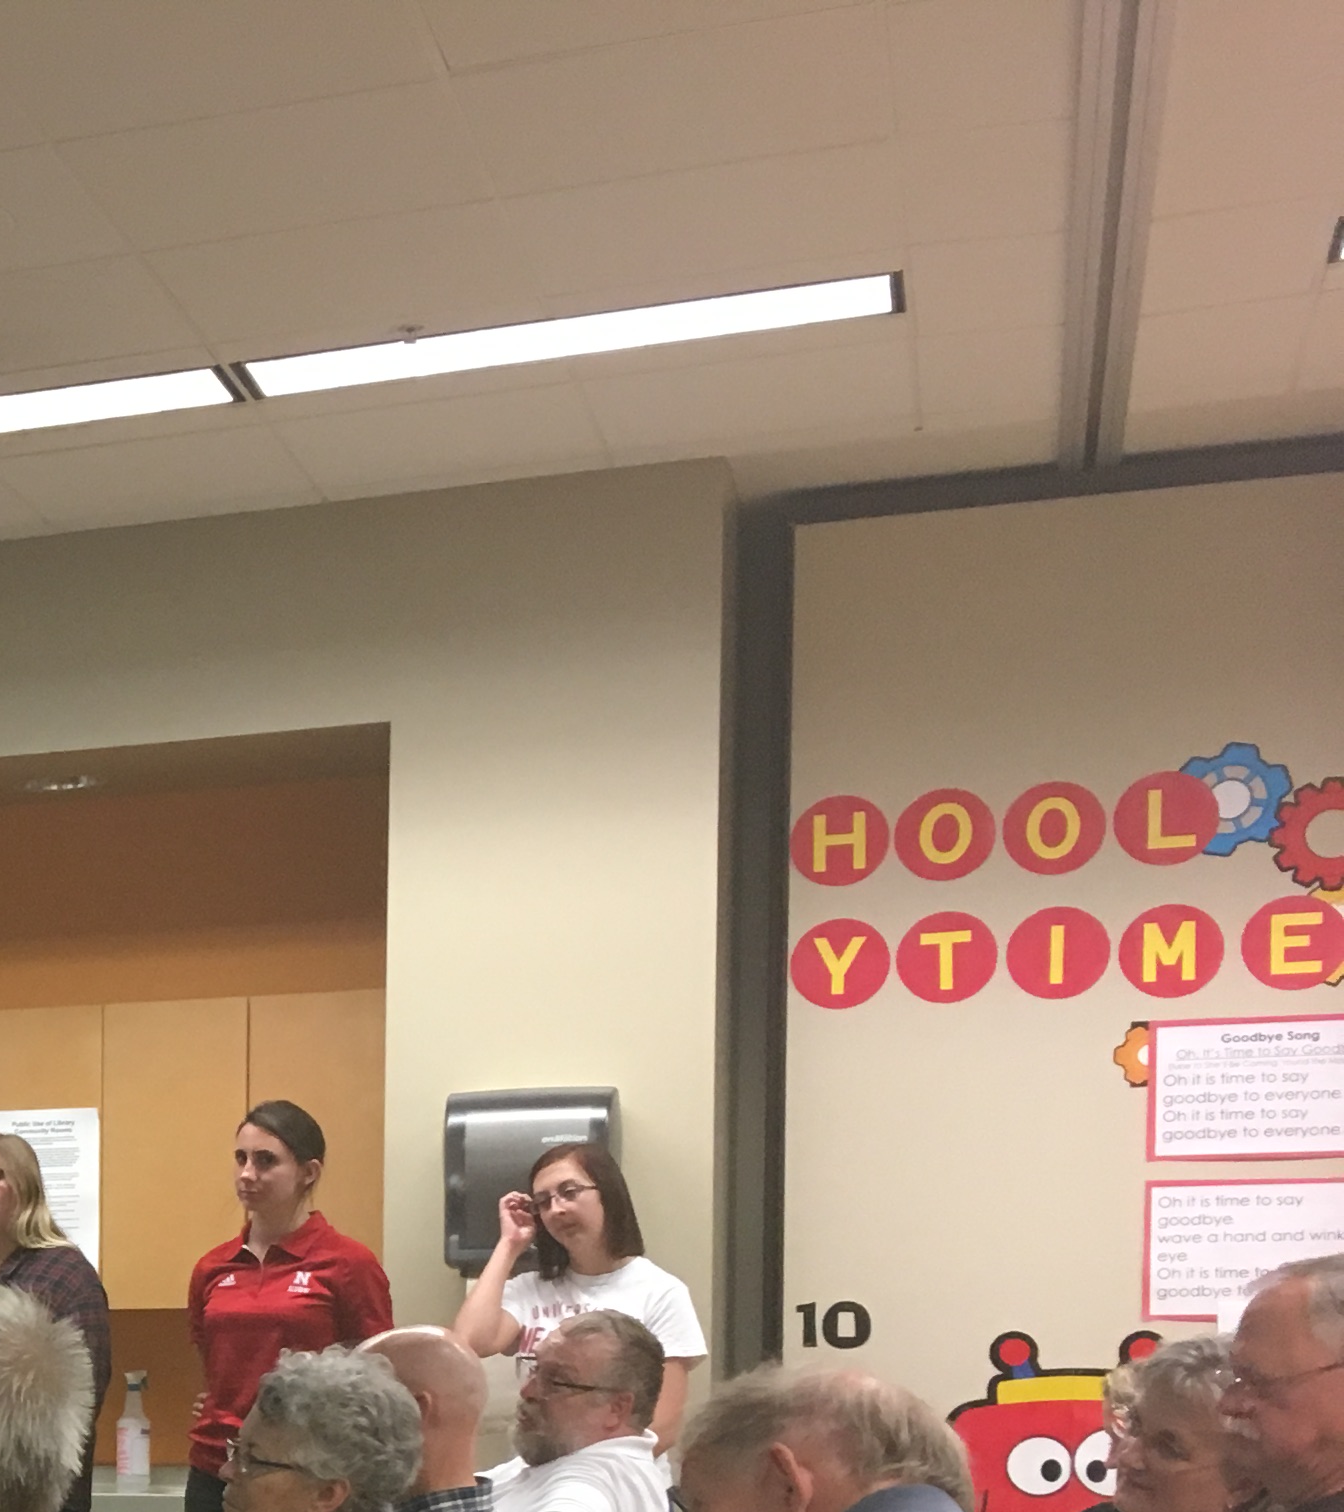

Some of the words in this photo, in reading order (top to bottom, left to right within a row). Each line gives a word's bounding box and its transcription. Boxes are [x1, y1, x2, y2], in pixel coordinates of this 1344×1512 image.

[812, 788, 1198, 874] HOOL
[813, 911, 1323, 995] YTIME
[1221, 1032, 1283, 1043] Goodbye
[1288, 1031, 1320, 1041] Song
[1259, 1047, 1271, 1057] to
[1274, 1046, 1298, 1057] Say
[1163, 1074, 1187, 1087] Oh
[1192, 1073, 1200, 1085] it
[1206, 1072, 1215, 1085] is
[1221, 1072, 1256, 1084] time
[1262, 1071, 1277, 1083] to
[1282, 1072, 1309, 1085] say
[1163, 1091, 1238, 1107] goodbye
[1244, 1090, 1260, 1101] to
[1163, 1110, 1187, 1122] Oh
[1191, 1109, 1200, 1121] it
[1205, 1109, 1215, 1121] is
[1220, 1108, 1255, 1120] time
[1261, 1107, 1277, 1119] to
[1282, 1108, 1308, 1120] say
[1162, 1127, 1237, 1143] goodbye
[1243, 1127, 1259, 1138] to
[1158, 1196, 1182, 1208] Oh
[1187, 1196, 1195, 1207] it
[1201, 1195, 1210, 1207] is
[1215, 1195, 1250, 1206] time
[1256, 1195, 1272, 1206] to
[1277, 1195, 1303, 1207] say
[1158, 1214, 1233, 1229] goodbye
[1157, 1233, 1202, 1243] wave
[1207, 1233, 1218, 1243] a
[1223, 1231, 1266, 1242] hand
[1271, 1230, 1304, 1242] and
[1157, 1251, 1188, 1263] eye
[293, 1271, 312, 1286] N
[1157, 1267, 1181, 1280] Oh
[1186, 1267, 1195, 1278] it
[1200, 1267, 1209, 1278] is
[1215, 1267, 1249, 1278] time
[1157, 1285, 1232, 1301] goodbye
[796, 1301, 871, 1349] 10
